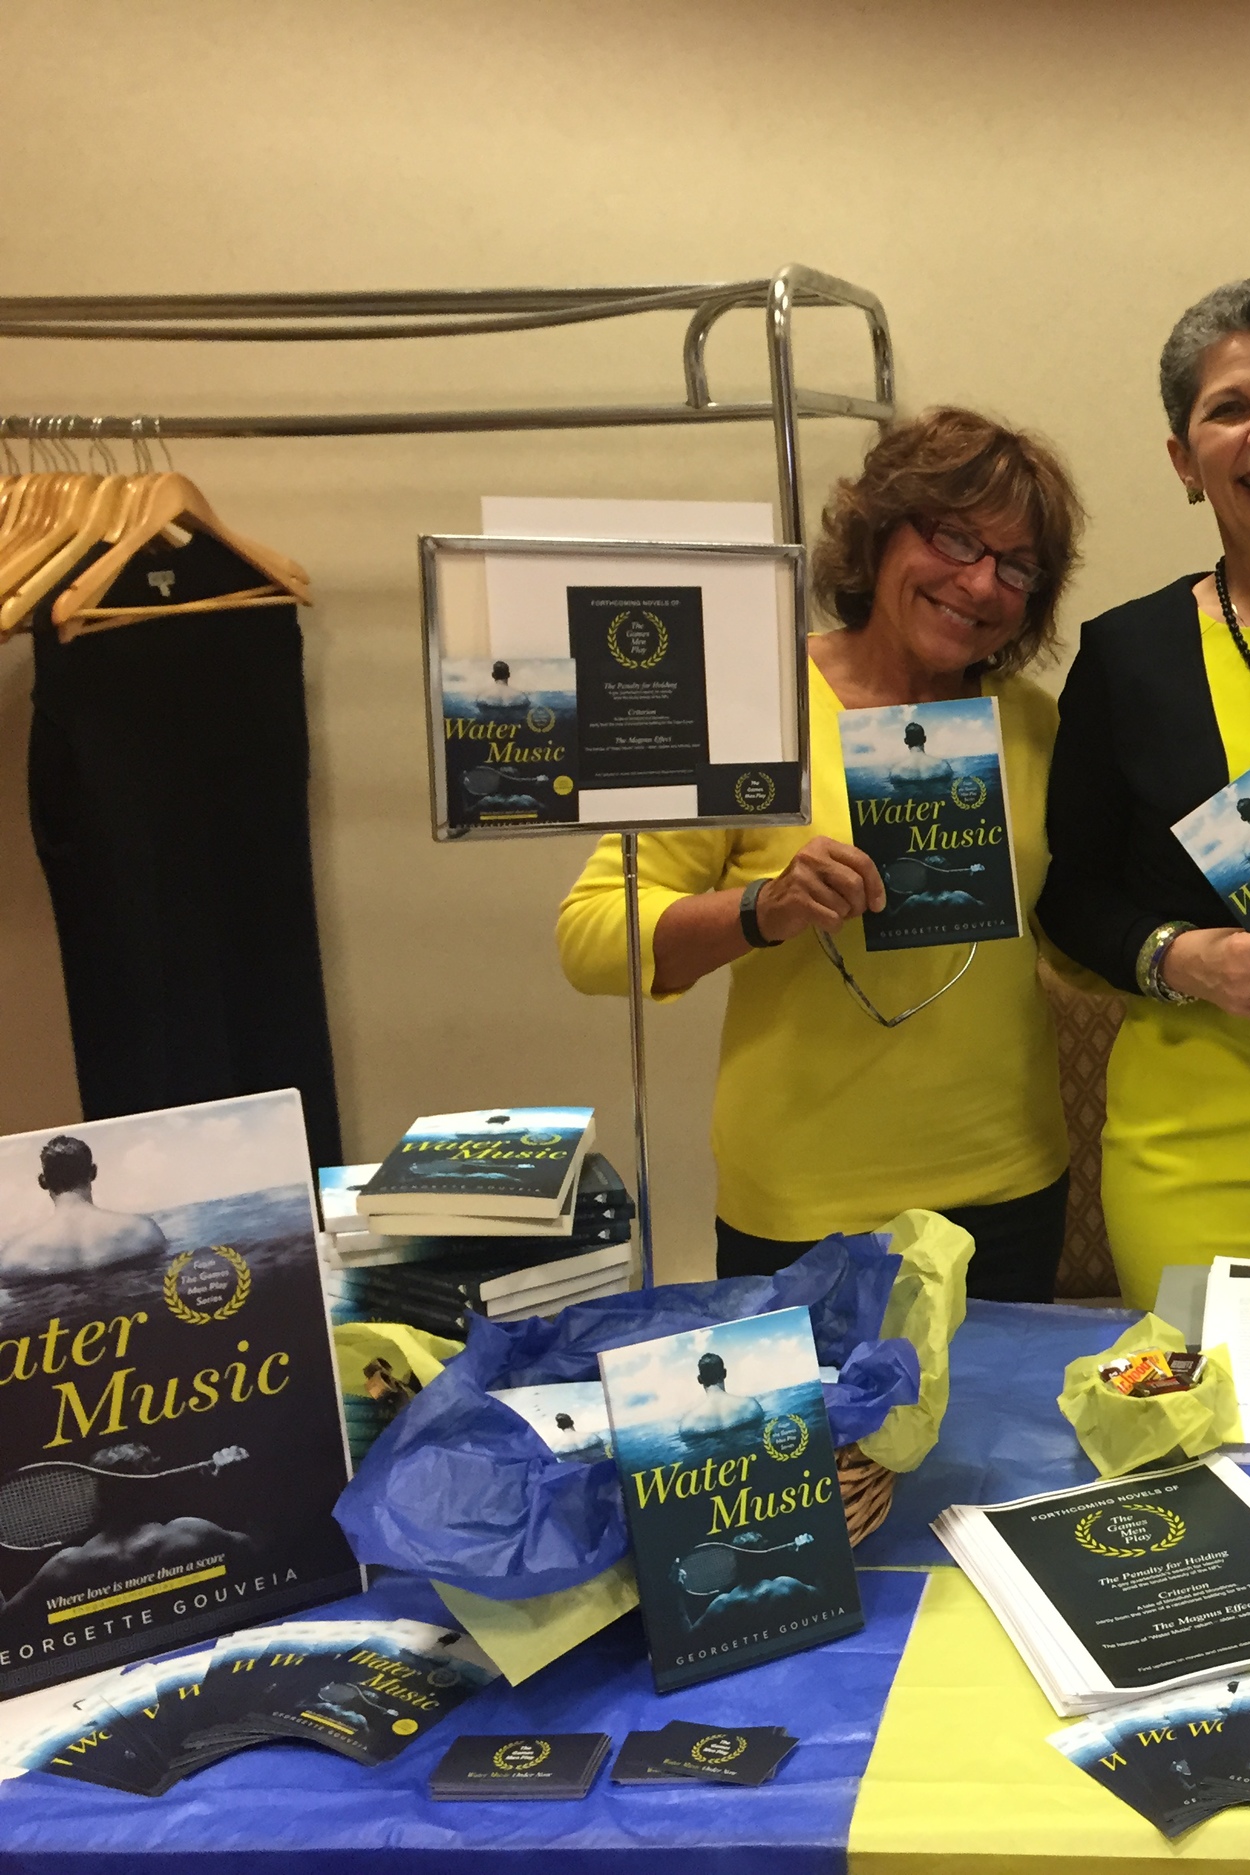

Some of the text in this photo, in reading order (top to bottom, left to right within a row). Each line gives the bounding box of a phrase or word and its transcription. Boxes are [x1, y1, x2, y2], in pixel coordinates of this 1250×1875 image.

[617, 682, 639, 690] Penalty
[652, 681, 677, 689] Holding
[444, 718, 521, 739] Water
[484, 740, 565, 763] Music
[856, 797, 946, 826] Water
[906, 818, 1003, 853] Music
[881, 920, 1005, 938] GEORGETTE GOUVEIA
[402, 1140, 511, 1153] Water
[449, 1148, 567, 1160] Music
[194, 1258, 216, 1270] From
[199, 1270, 229, 1280] Games
[187, 1282, 228, 1294] Men Play
[196, 1295, 222, 1306] Series
[0, 1311, 148, 1386] ater
[42, 1340, 290, 1450] Music
[631, 1452, 757, 1510] Water
[706, 1469, 833, 1536] Music
[1031, 1498, 1114, 1522] FORTHCOMING
[1117, 1489, 1162, 1502] NOVELS
[1106, 1518, 1148, 1532] Games
[1110, 1514, 1133, 1524] The
[1120, 1526, 1146, 1537] Men
[1124, 1533, 1152, 1544] Play
[1098, 1576, 1119, 1586] The
[1122, 1566, 1163, 1580] Penalty
[1165, 1561, 1181, 1571] for
[1184, 1550, 1230, 1565] Holding
[46, 1553, 225, 1610] Where love is more than a score
[1158, 1582, 1209, 1599] Criterion
[0, 1609, 154, 1666] EORGETTE
[173, 1568, 298, 1615] GOUVEIA
[1153, 1621, 1175, 1632] The
[1178, 1608, 1222, 1625] Magnus
[676, 1606, 847, 1666] GEORGETTE GOUVEIA
[348, 1650, 422, 1679] Water
[357, 1672, 440, 1711] Music
